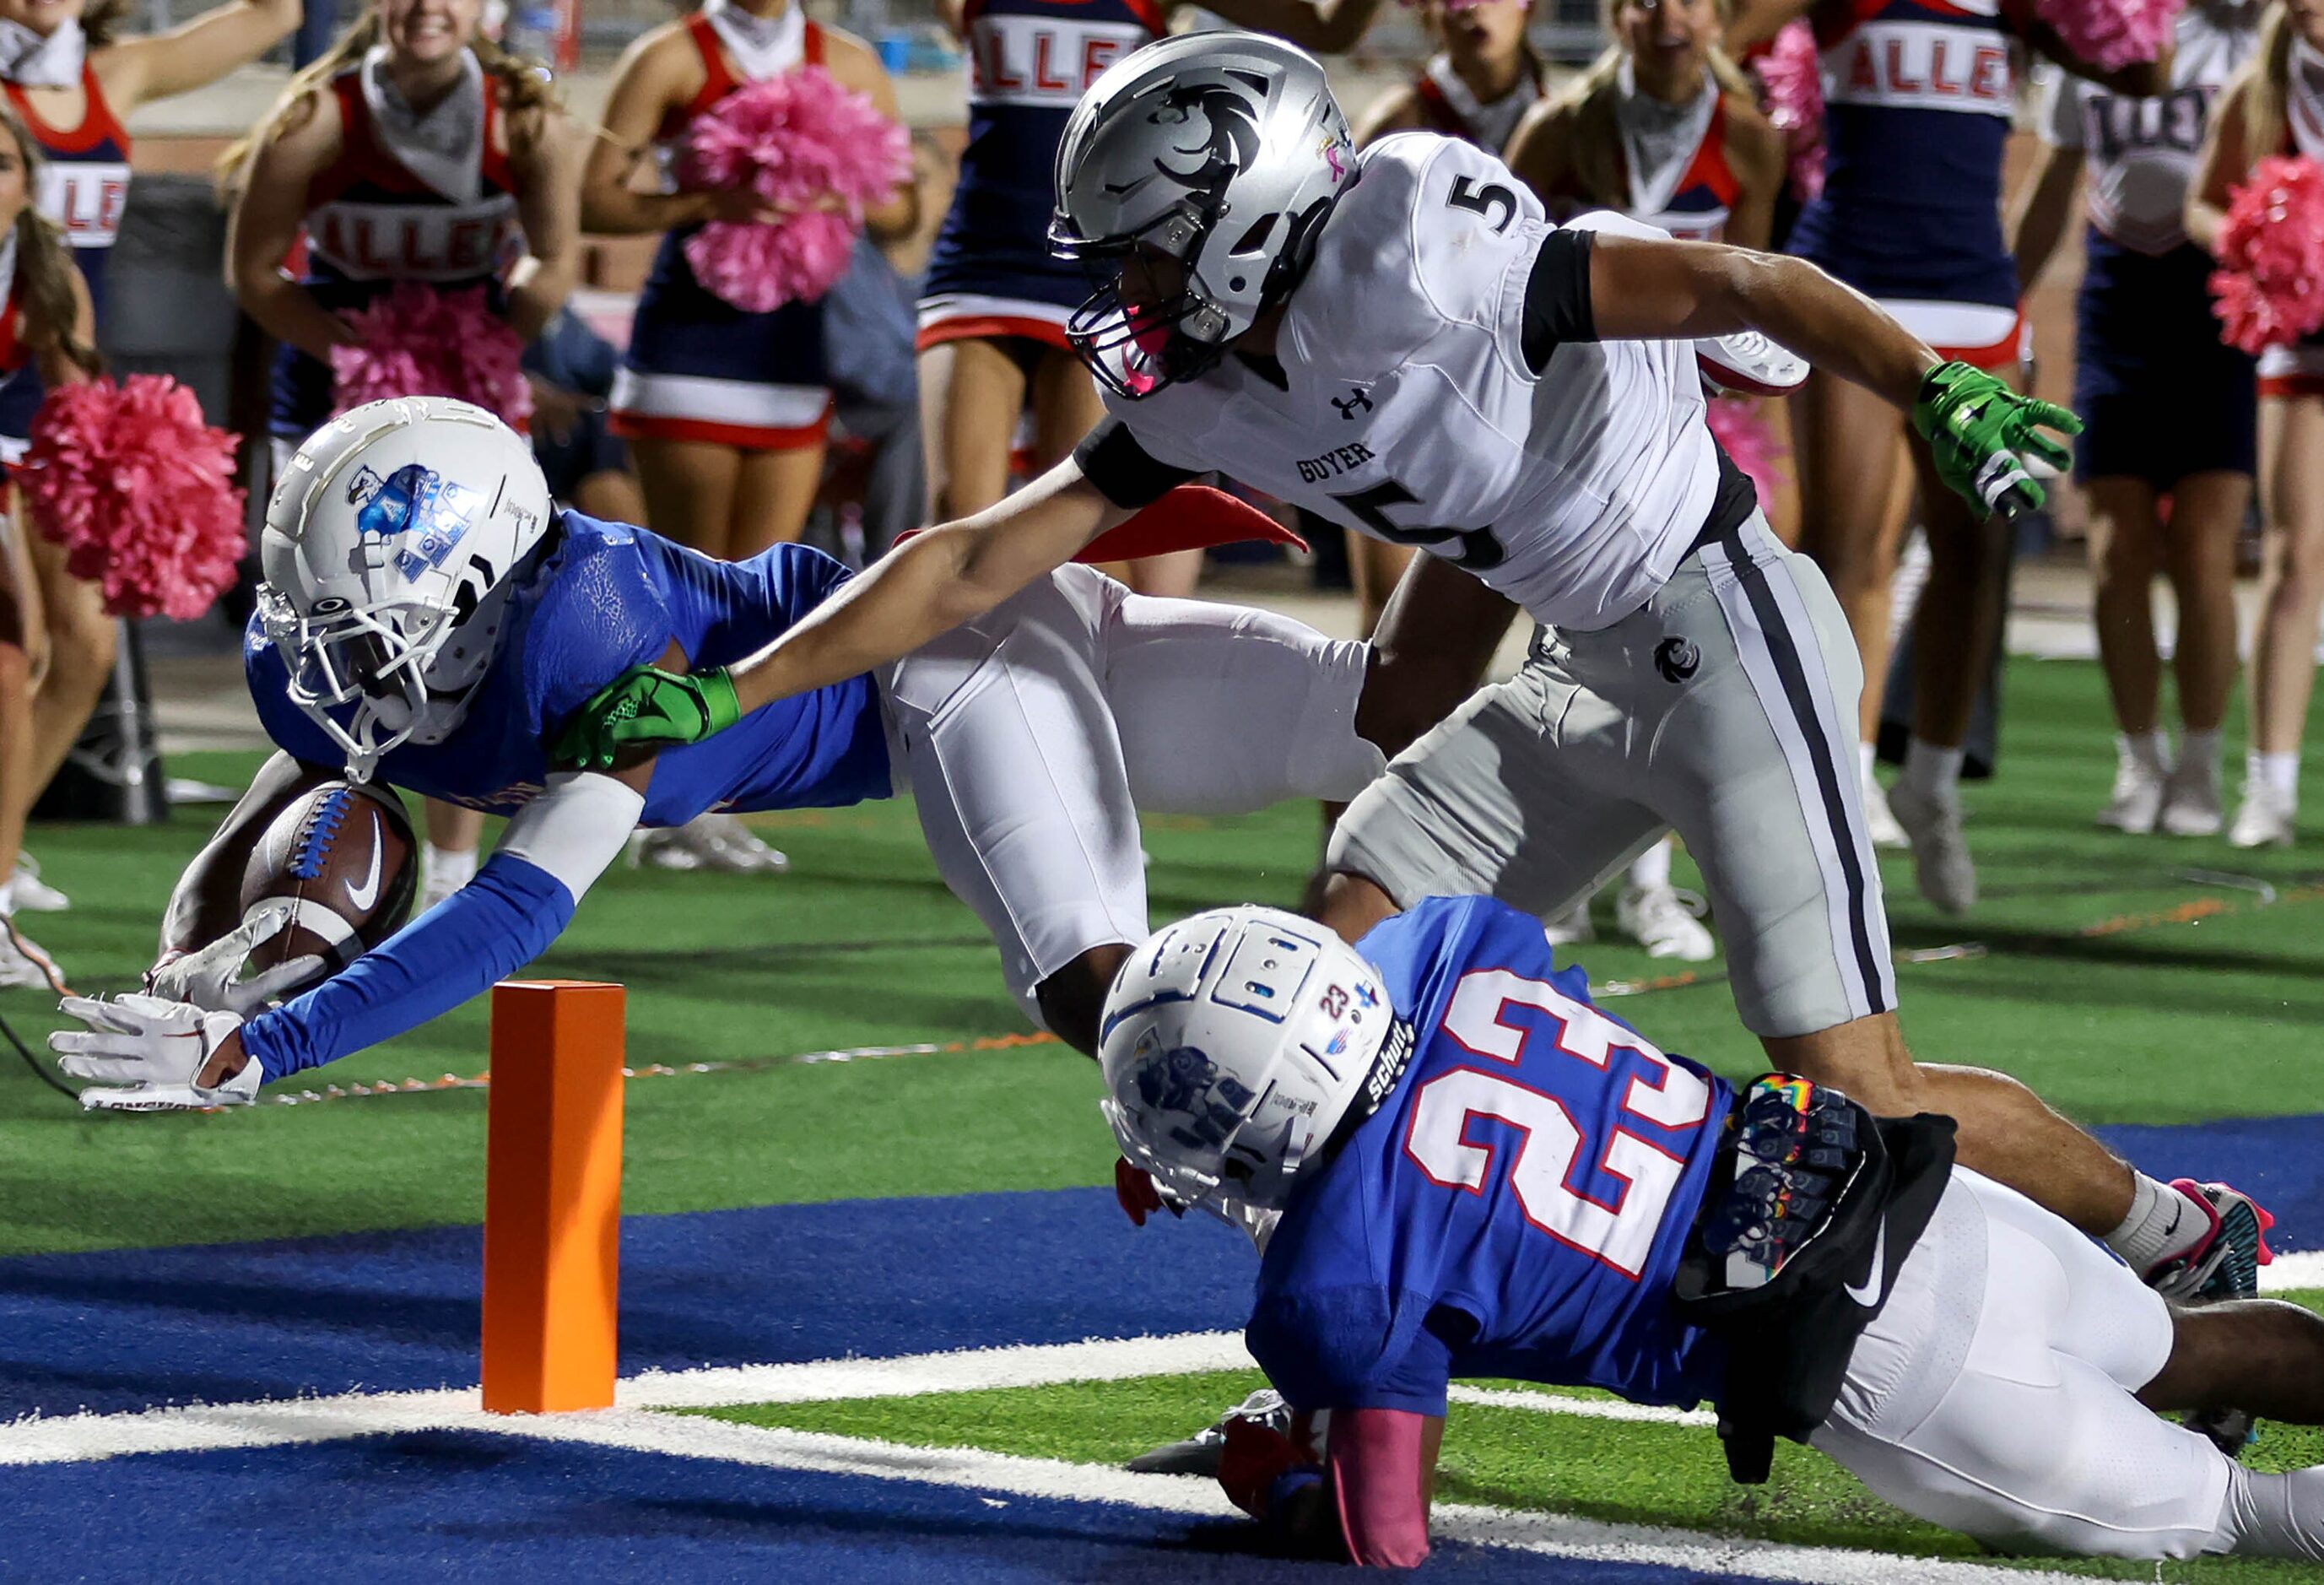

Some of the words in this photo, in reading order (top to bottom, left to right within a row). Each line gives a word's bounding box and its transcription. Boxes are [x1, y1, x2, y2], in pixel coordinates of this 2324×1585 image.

[1853, 39, 2015, 98] ALLE
[1445, 173, 1517, 237] 5
[1296, 442, 1375, 484] GUYER
[1325, 477, 1509, 571] 5
[1320, 982, 1349, 1020] 23
[1402, 967, 1713, 1283] 23
